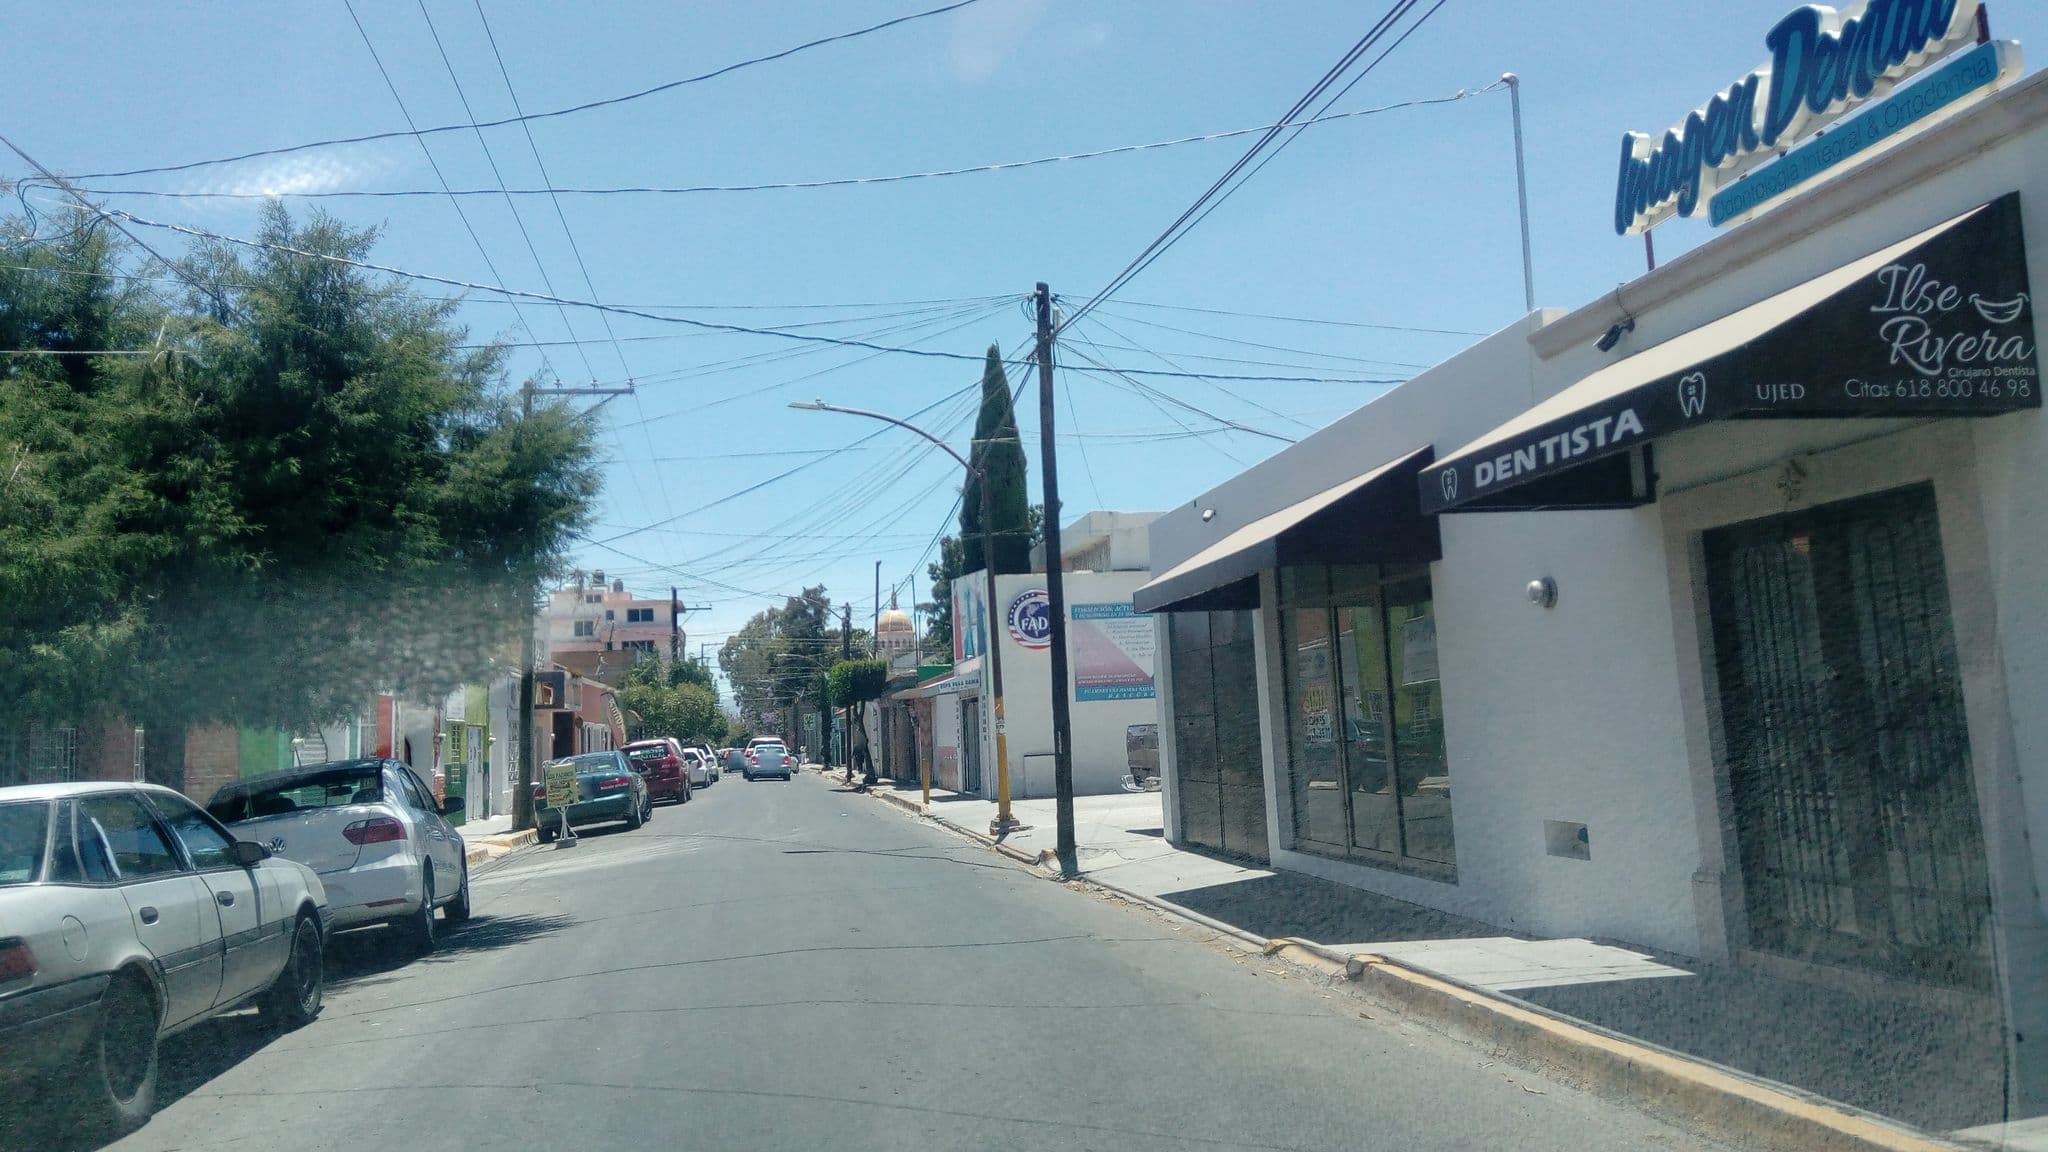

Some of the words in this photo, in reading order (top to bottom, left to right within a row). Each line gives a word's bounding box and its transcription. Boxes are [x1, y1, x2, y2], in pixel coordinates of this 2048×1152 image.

[1802, 133, 1861, 169] Integral
[1867, 116, 1879, 139] &
[1882, 59, 1992, 127] Ortodoncia
[1615, 72, 1759, 236] Imagen
[1870, 263, 1963, 314] Ilse
[1880, 316, 2035, 376] Rivera
[1756, 383, 1806, 403] UJED
[1845, 379, 1890, 398] Citas
[1896, 379, 1932, 398] 618
[1937, 379, 1973, 398] 800
[1979, 379, 2001, 398] 46
[2007, 379, 2031, 397] 98
[1948, 367, 1992, 379] Cirujano
[1994, 366, 2036, 377] Dentista
[1474, 408, 1644, 488] DENTISTA
[1021, 616, 1049, 631] FAD
